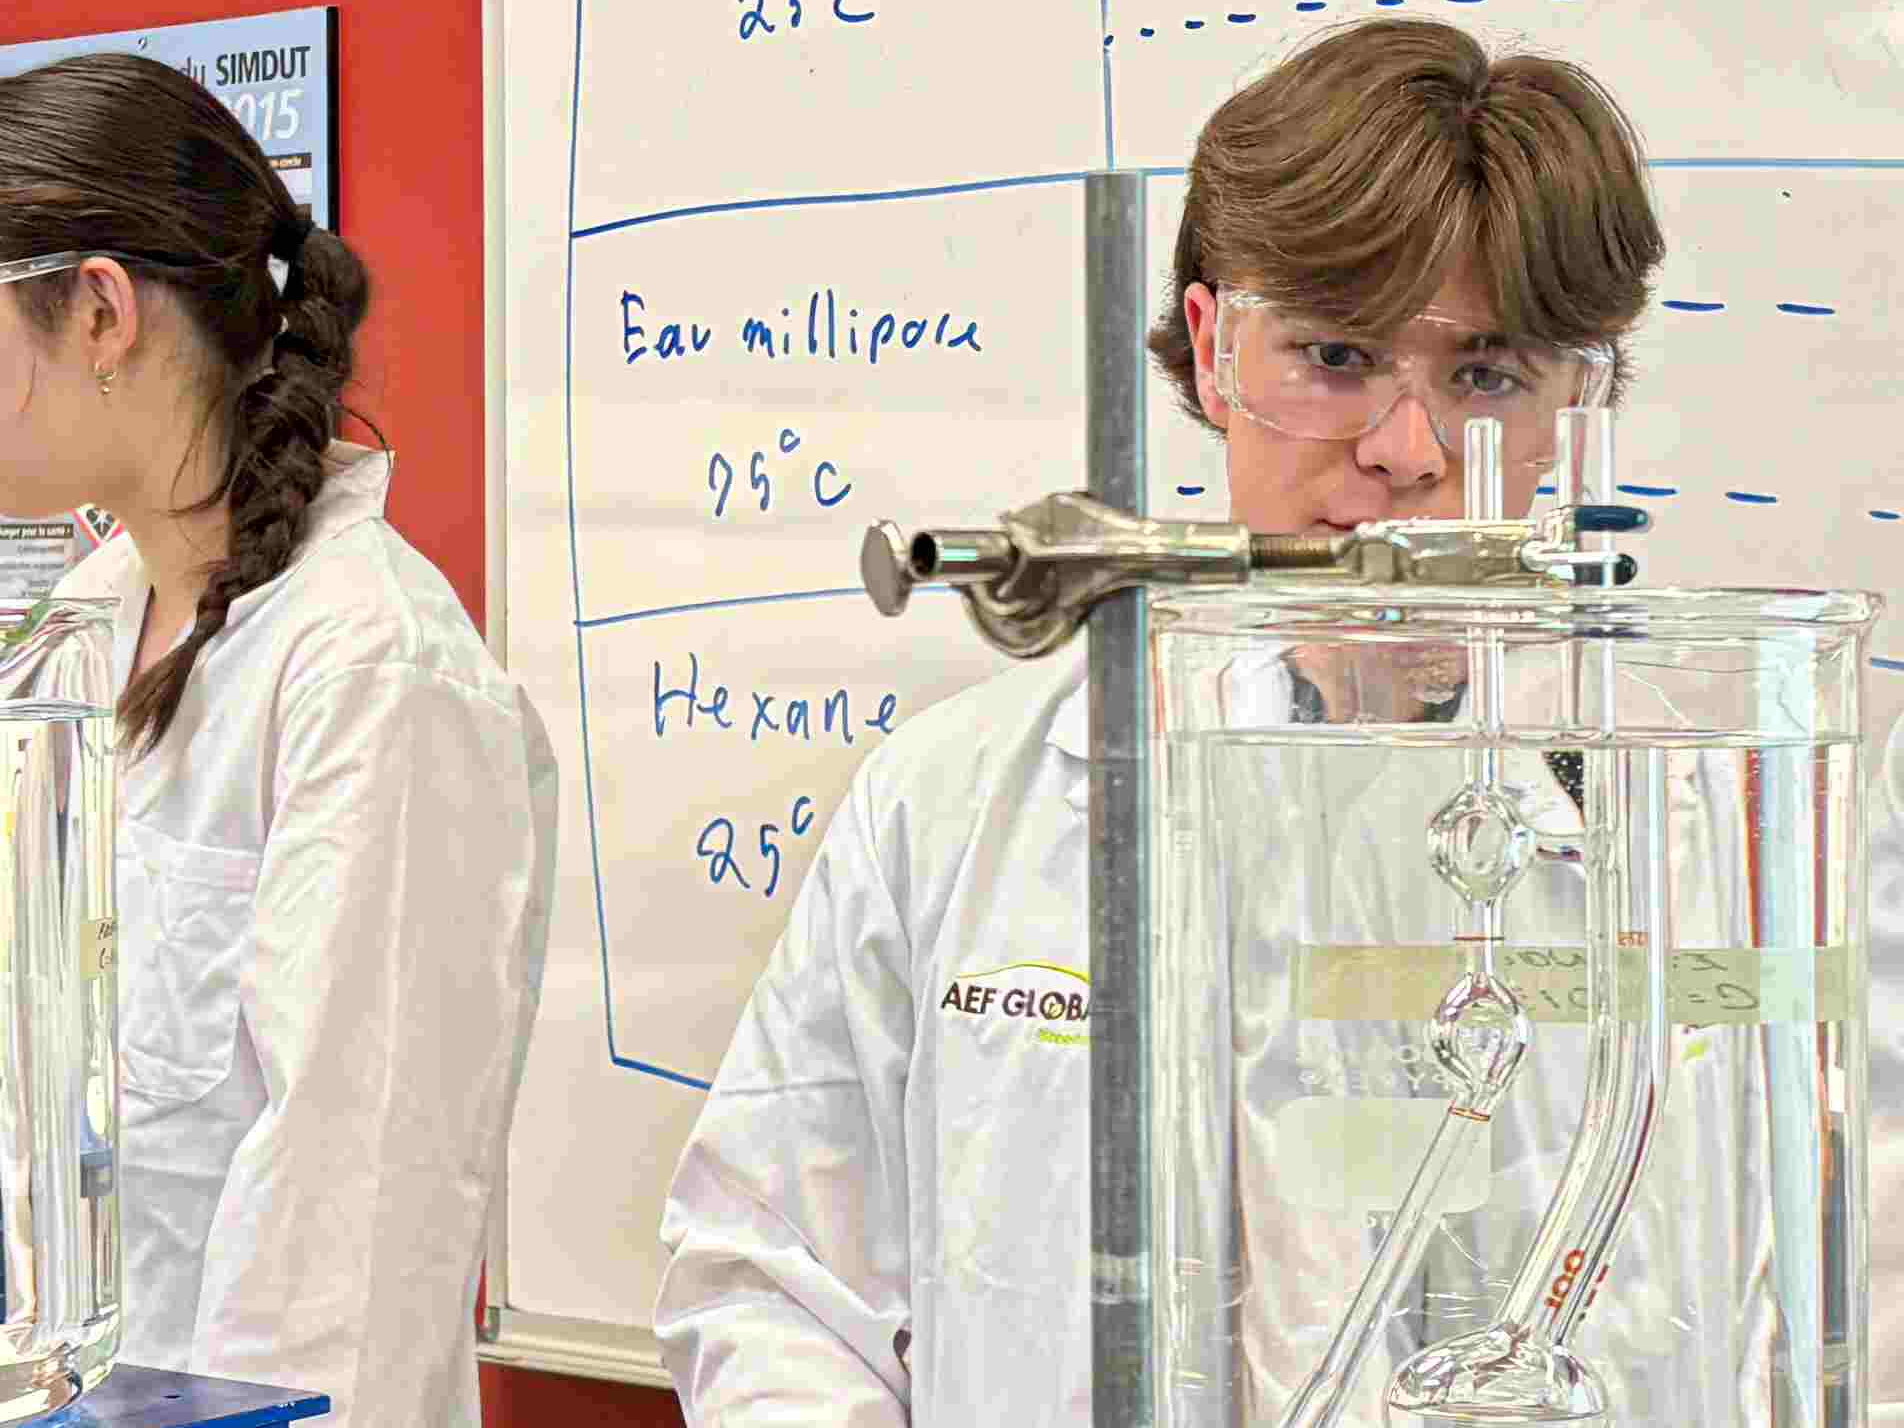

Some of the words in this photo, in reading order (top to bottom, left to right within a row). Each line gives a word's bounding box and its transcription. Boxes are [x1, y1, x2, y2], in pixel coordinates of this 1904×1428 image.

[215, 45, 311, 87] SIMDUT
[220, 89, 303, 140] 015
[653, 652, 898, 744] Hexane
[941, 981, 998, 1015] AEF
